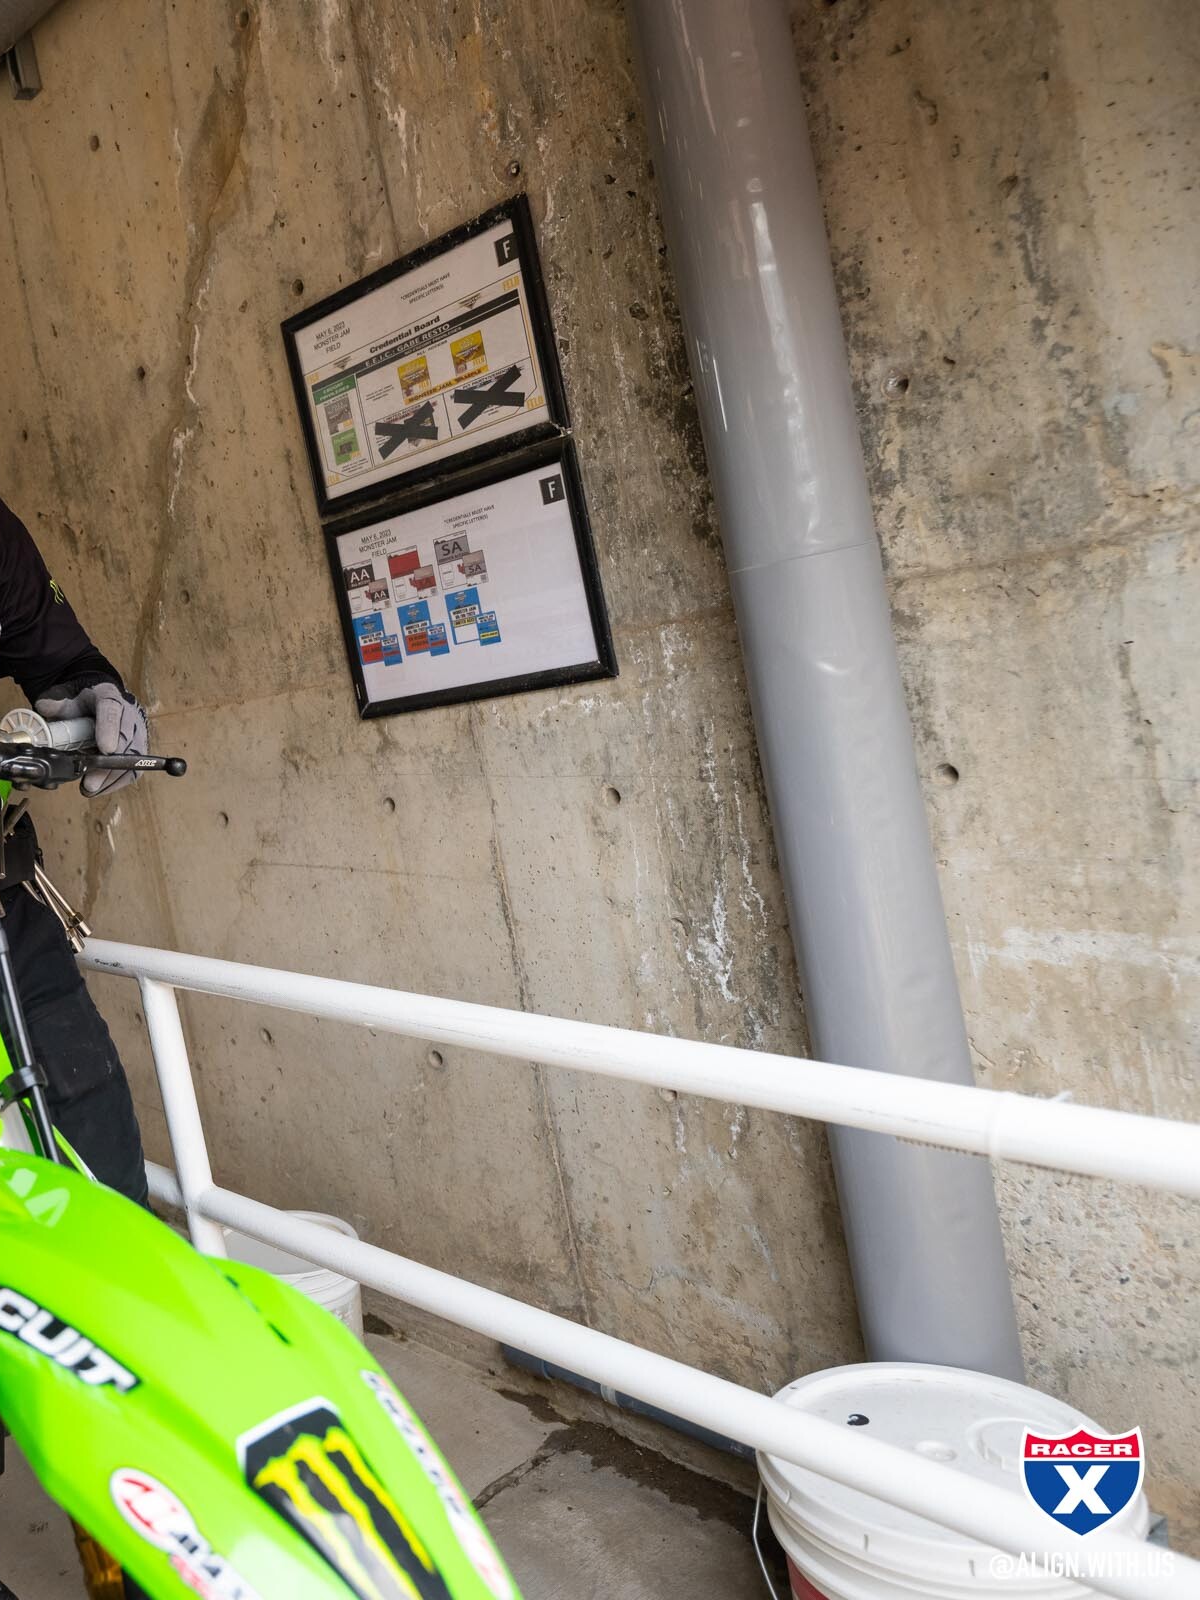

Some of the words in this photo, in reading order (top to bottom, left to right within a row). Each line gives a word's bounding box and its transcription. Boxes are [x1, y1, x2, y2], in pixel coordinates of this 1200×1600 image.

[503, 240, 510, 259] F
[313, 332, 339, 351] MONSTER
[338, 326, 350, 338] JAM
[315, 329, 326, 340] MAY
[369, 328, 412, 354] Credential
[413, 314, 440, 333] Board
[395, 336, 419, 353] GABE
[421, 322, 450, 341] RESTO
[325, 341, 341, 354] FIELD
[548, 481, 555, 499] F
[358, 539, 385, 553] MONSTER
[385, 534, 397, 545] JAM
[360, 534, 373, 544] MAY
[378, 528, 391, 538] 2023
[370, 547, 387, 558] FIELD
[441, 541, 462, 557] SA
[350, 568, 370, 584] AA
[468, 563, 482, 574] SA
[374, 590, 386, 600] AA
[135, 759, 157, 767] ARC
